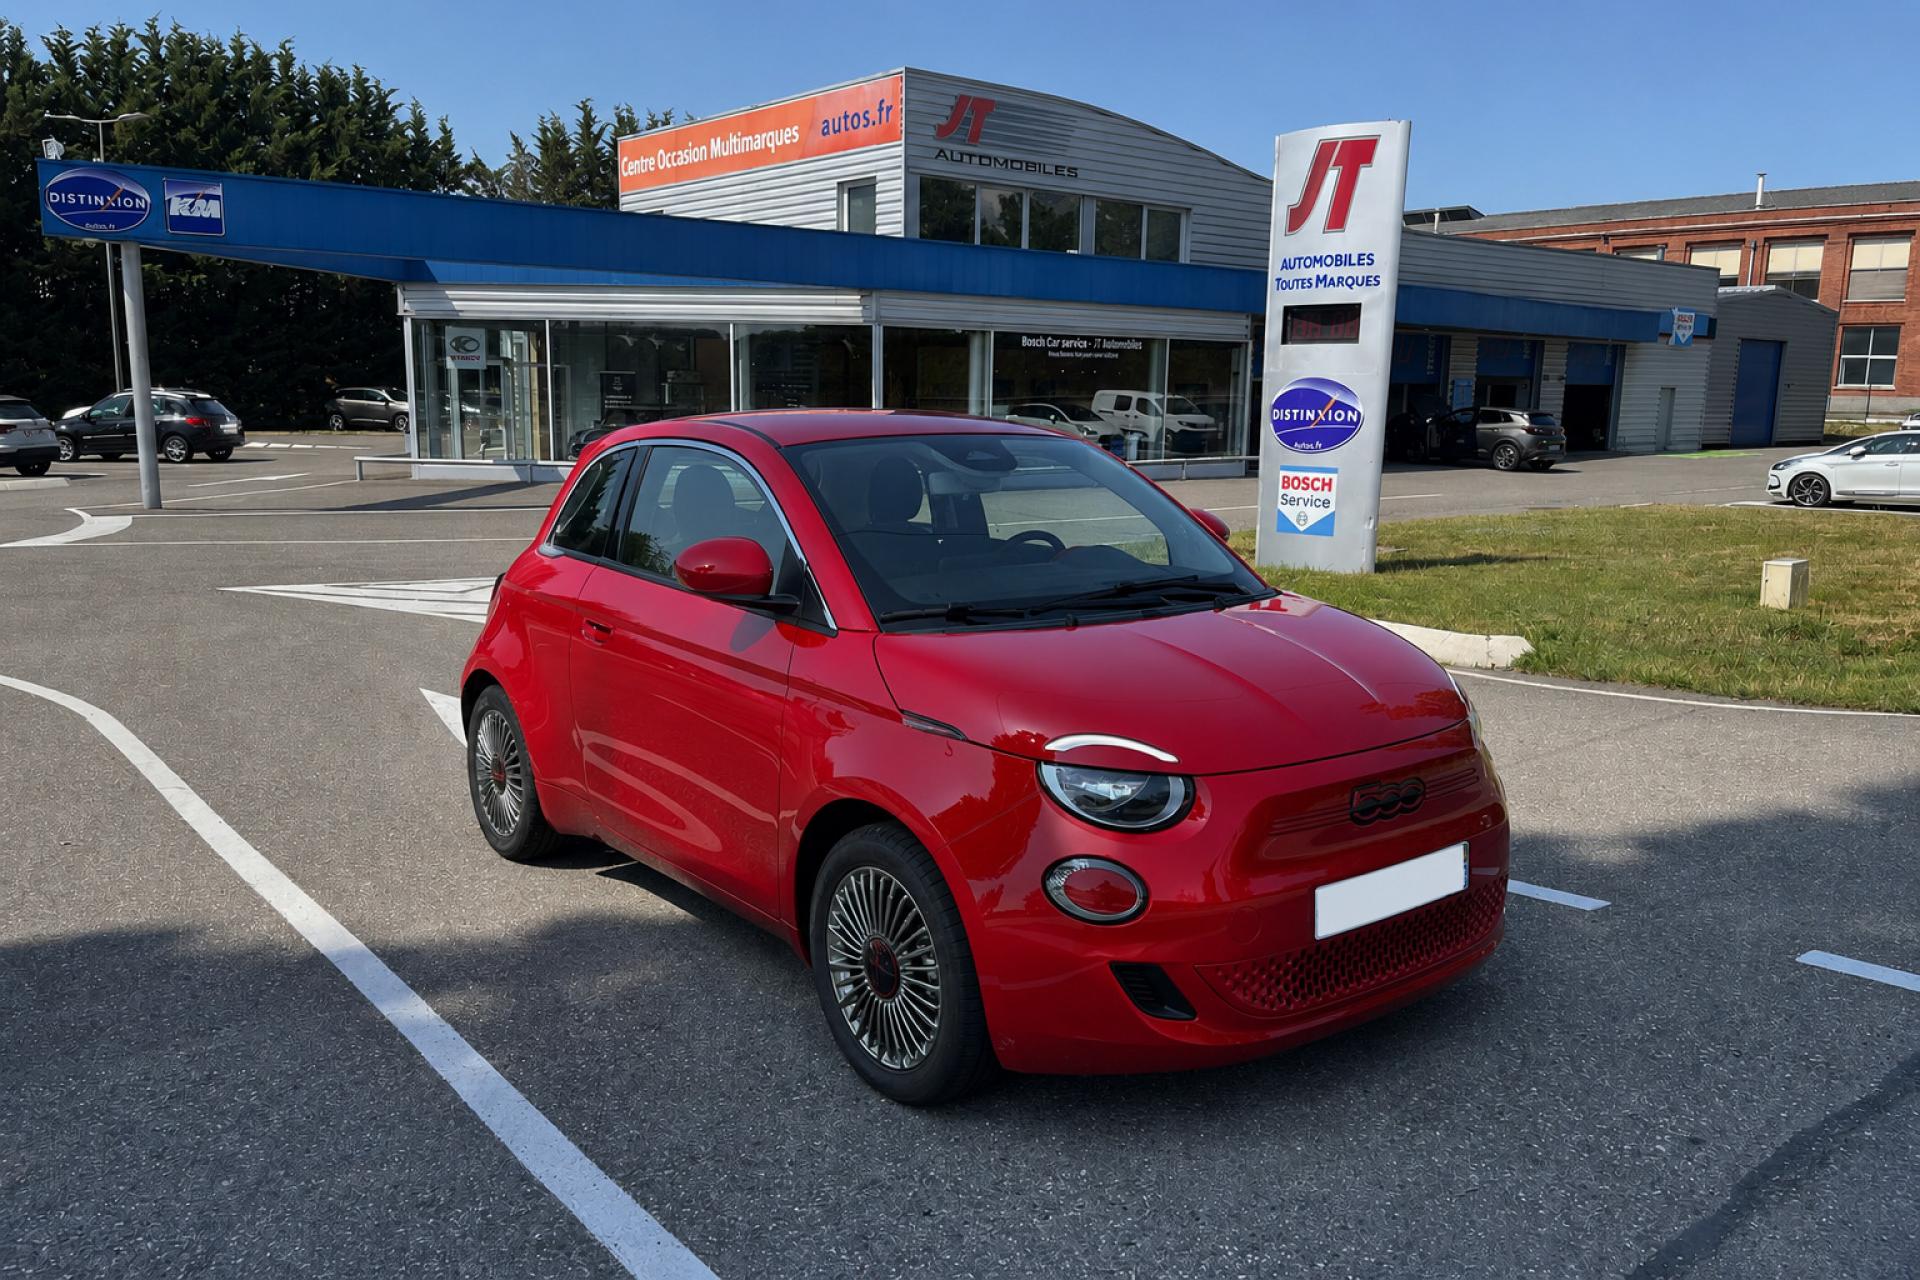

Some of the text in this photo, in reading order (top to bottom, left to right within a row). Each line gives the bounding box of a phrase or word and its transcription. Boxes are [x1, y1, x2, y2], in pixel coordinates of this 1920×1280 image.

[821, 99, 893, 137] autos.fr
[934, 94, 997, 145] JT
[621, 125, 799, 177] Centre Occasion Multimarques
[934, 149, 1079, 178] AUTOMOBILES
[1285, 134, 1381, 236] JT
[49, 191, 146, 209] DISTINXION
[1280, 253, 1375, 271] AUTOMOBILES
[1275, 274, 1381, 291] TOUTES MARQUES
[1021, 335, 1045, 347] Bosch
[1046, 336, 1060, 348] Car
[1273, 409, 1358, 423] DISTINXION
[1281, 475, 1333, 492] BOSCH
[1280, 493, 1331, 509] Service
[1350, 776, 1425, 826] 500
